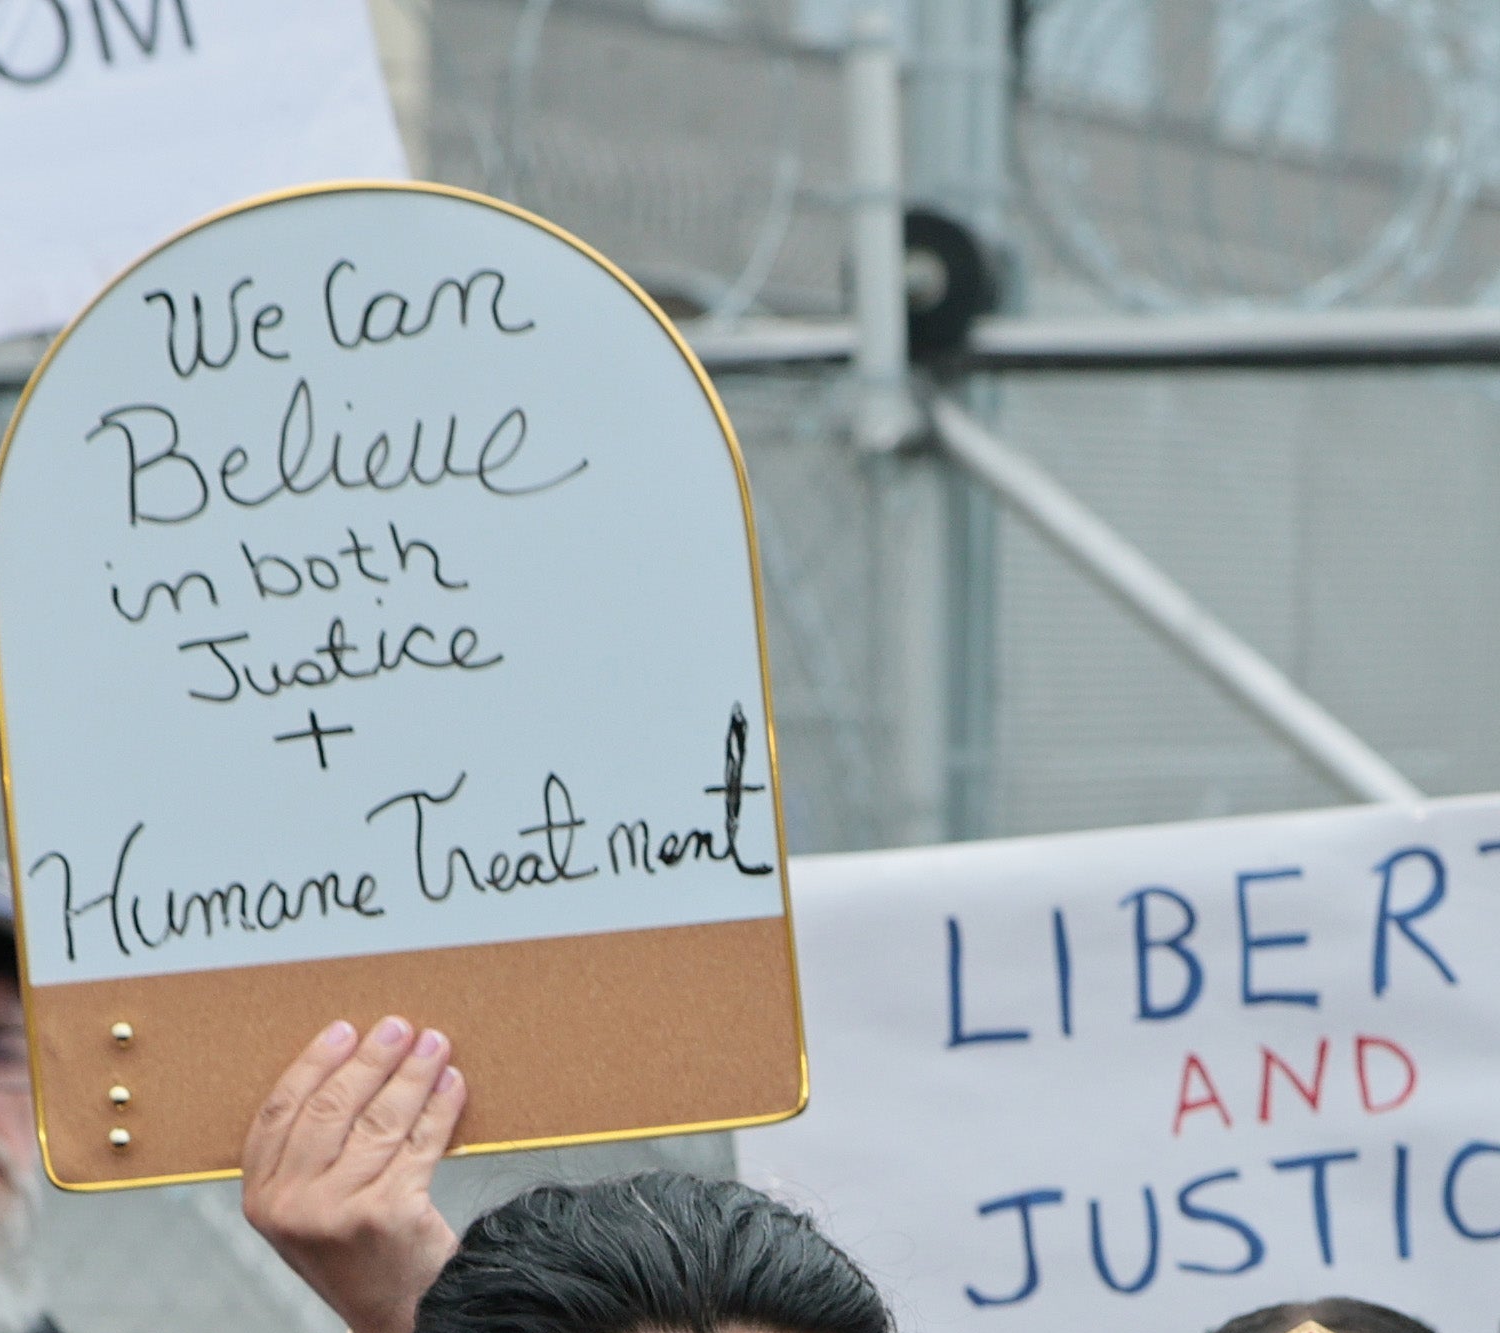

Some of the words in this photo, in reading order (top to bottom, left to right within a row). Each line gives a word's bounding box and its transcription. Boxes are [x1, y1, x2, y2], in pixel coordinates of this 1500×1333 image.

[143, 277, 290, 378] We
[324, 259, 536, 349] Can
[84, 378, 589, 527] Believe
[104, 560, 217, 623] in
[240, 523, 468, 599] both
[178, 598, 504, 703] Justice
[272, 709, 355, 770] +
[30, 821, 387, 962] Humane
[366, 699, 774, 904] Treatment
[1173, 1032, 1420, 1136] AND
